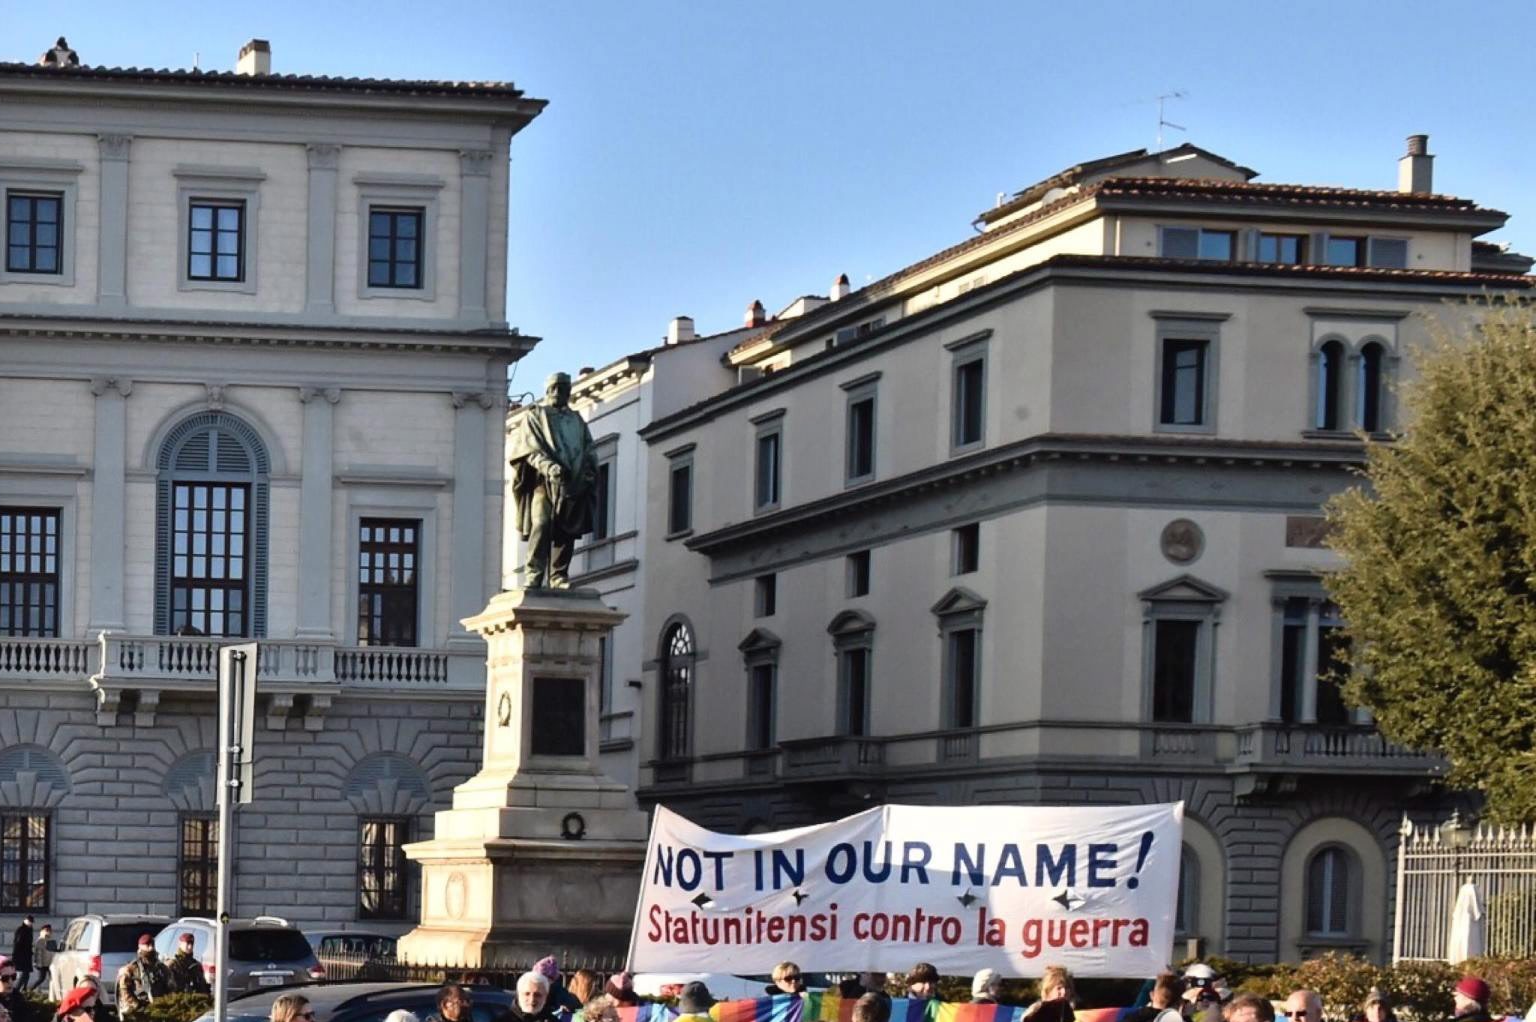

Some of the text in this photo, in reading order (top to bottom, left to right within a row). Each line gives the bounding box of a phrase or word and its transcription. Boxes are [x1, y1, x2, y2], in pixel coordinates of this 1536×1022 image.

[653, 830, 1154, 892] NOT IN OUR NAME!
[647, 902, 1150, 959] Statunitensi contro la guerra
